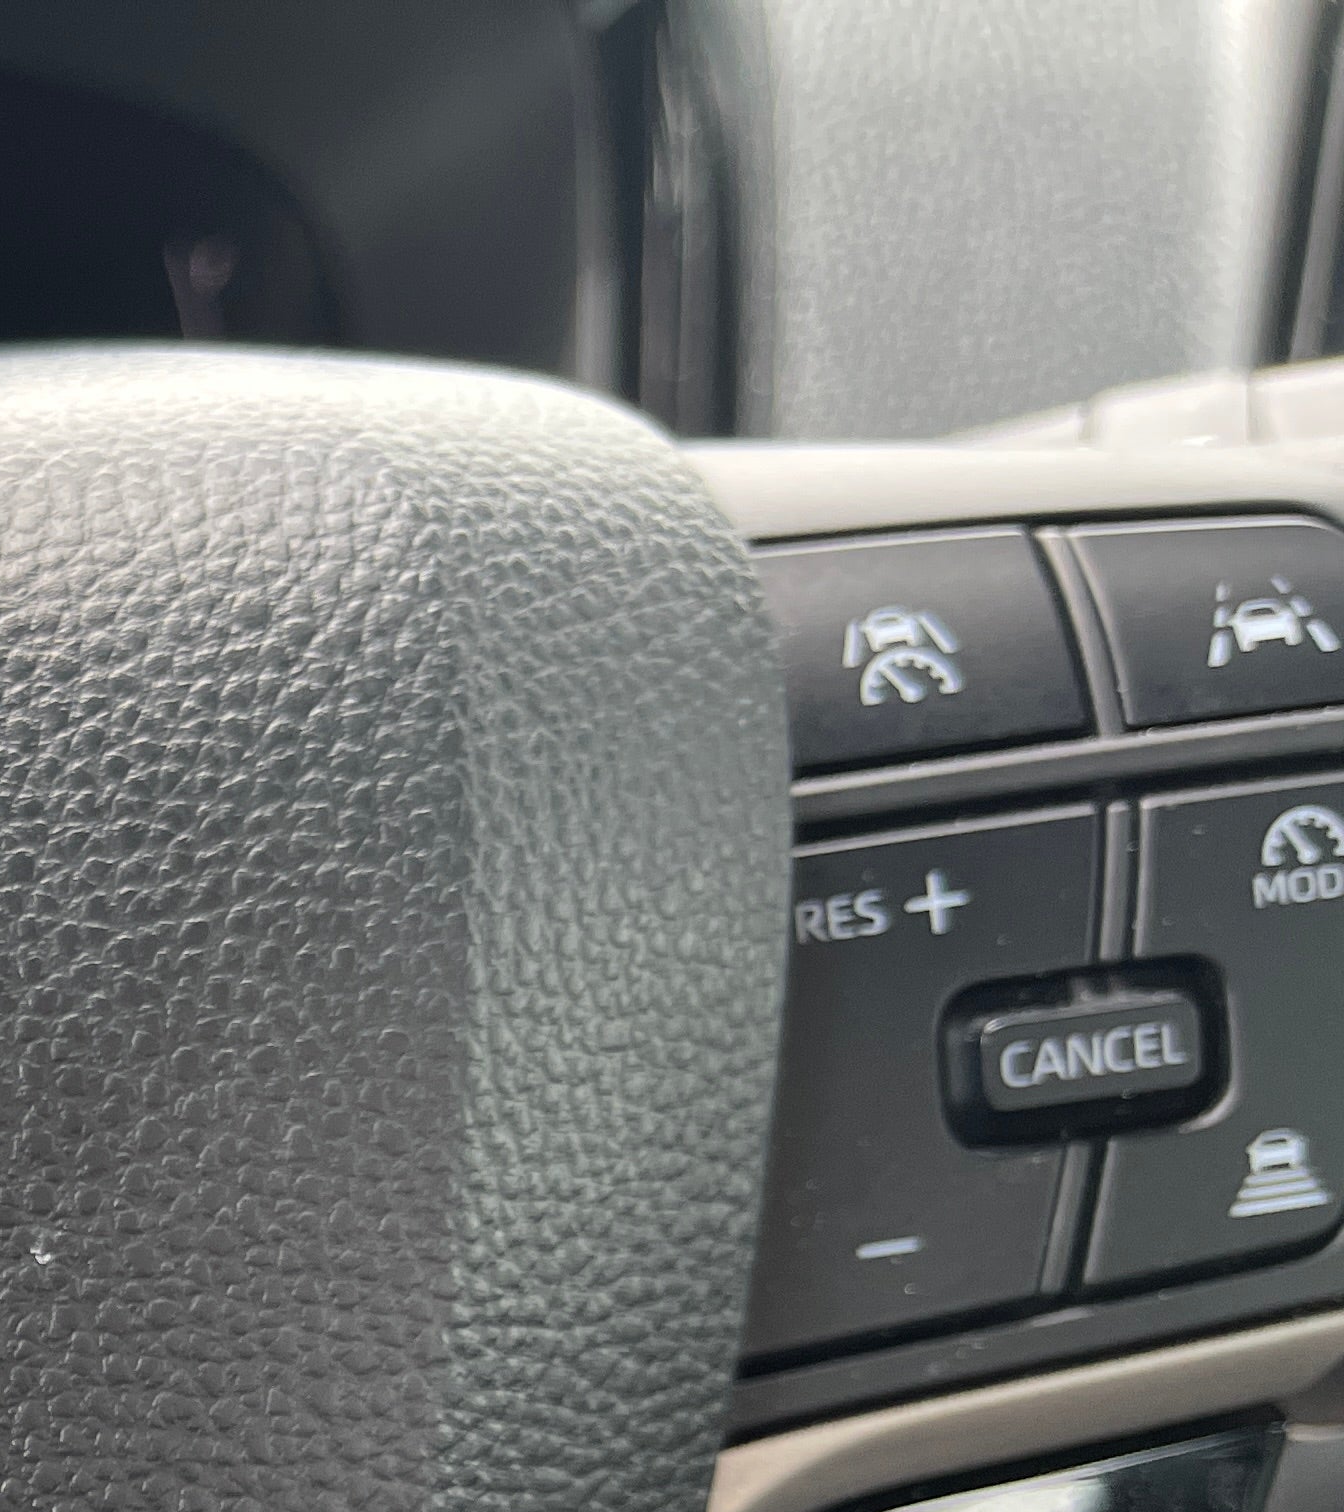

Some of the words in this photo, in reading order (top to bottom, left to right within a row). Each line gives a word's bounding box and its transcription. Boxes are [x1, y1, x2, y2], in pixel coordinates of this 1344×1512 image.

[1252, 862, 1344, 909] MOD
[793, 889, 891, 944] RES
[999, 1023, 1189, 1090] CANCEL
